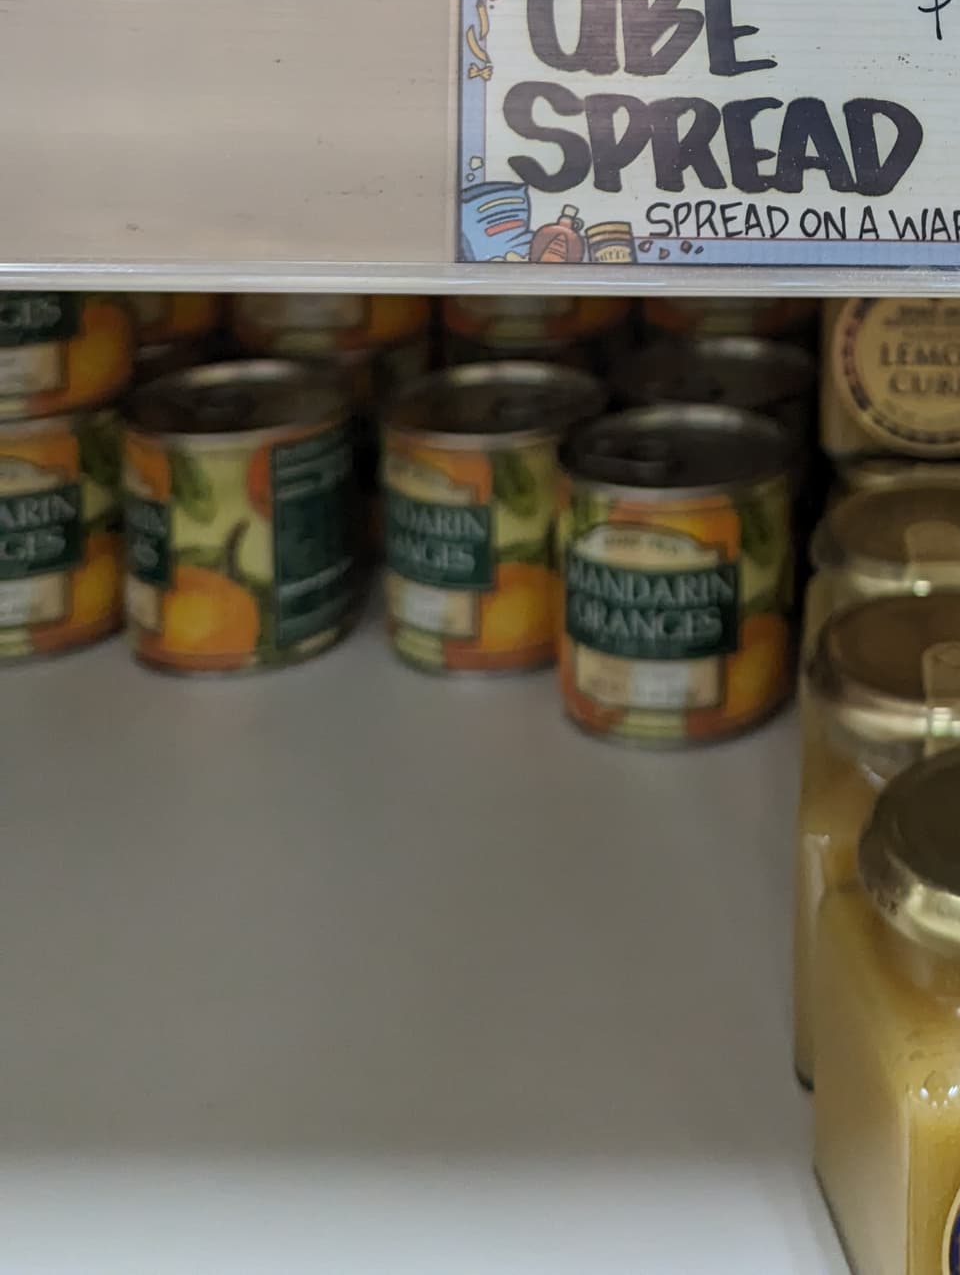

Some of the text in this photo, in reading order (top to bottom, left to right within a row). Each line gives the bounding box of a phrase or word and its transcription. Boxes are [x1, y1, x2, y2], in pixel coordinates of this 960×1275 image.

[502, 80, 924, 198] SPREAD
[646, 200, 790, 239] SPREAD
[799, 207, 847, 240] ON
[858, 207, 880, 241] A
[568, 559, 734, 607] MANDARIN
